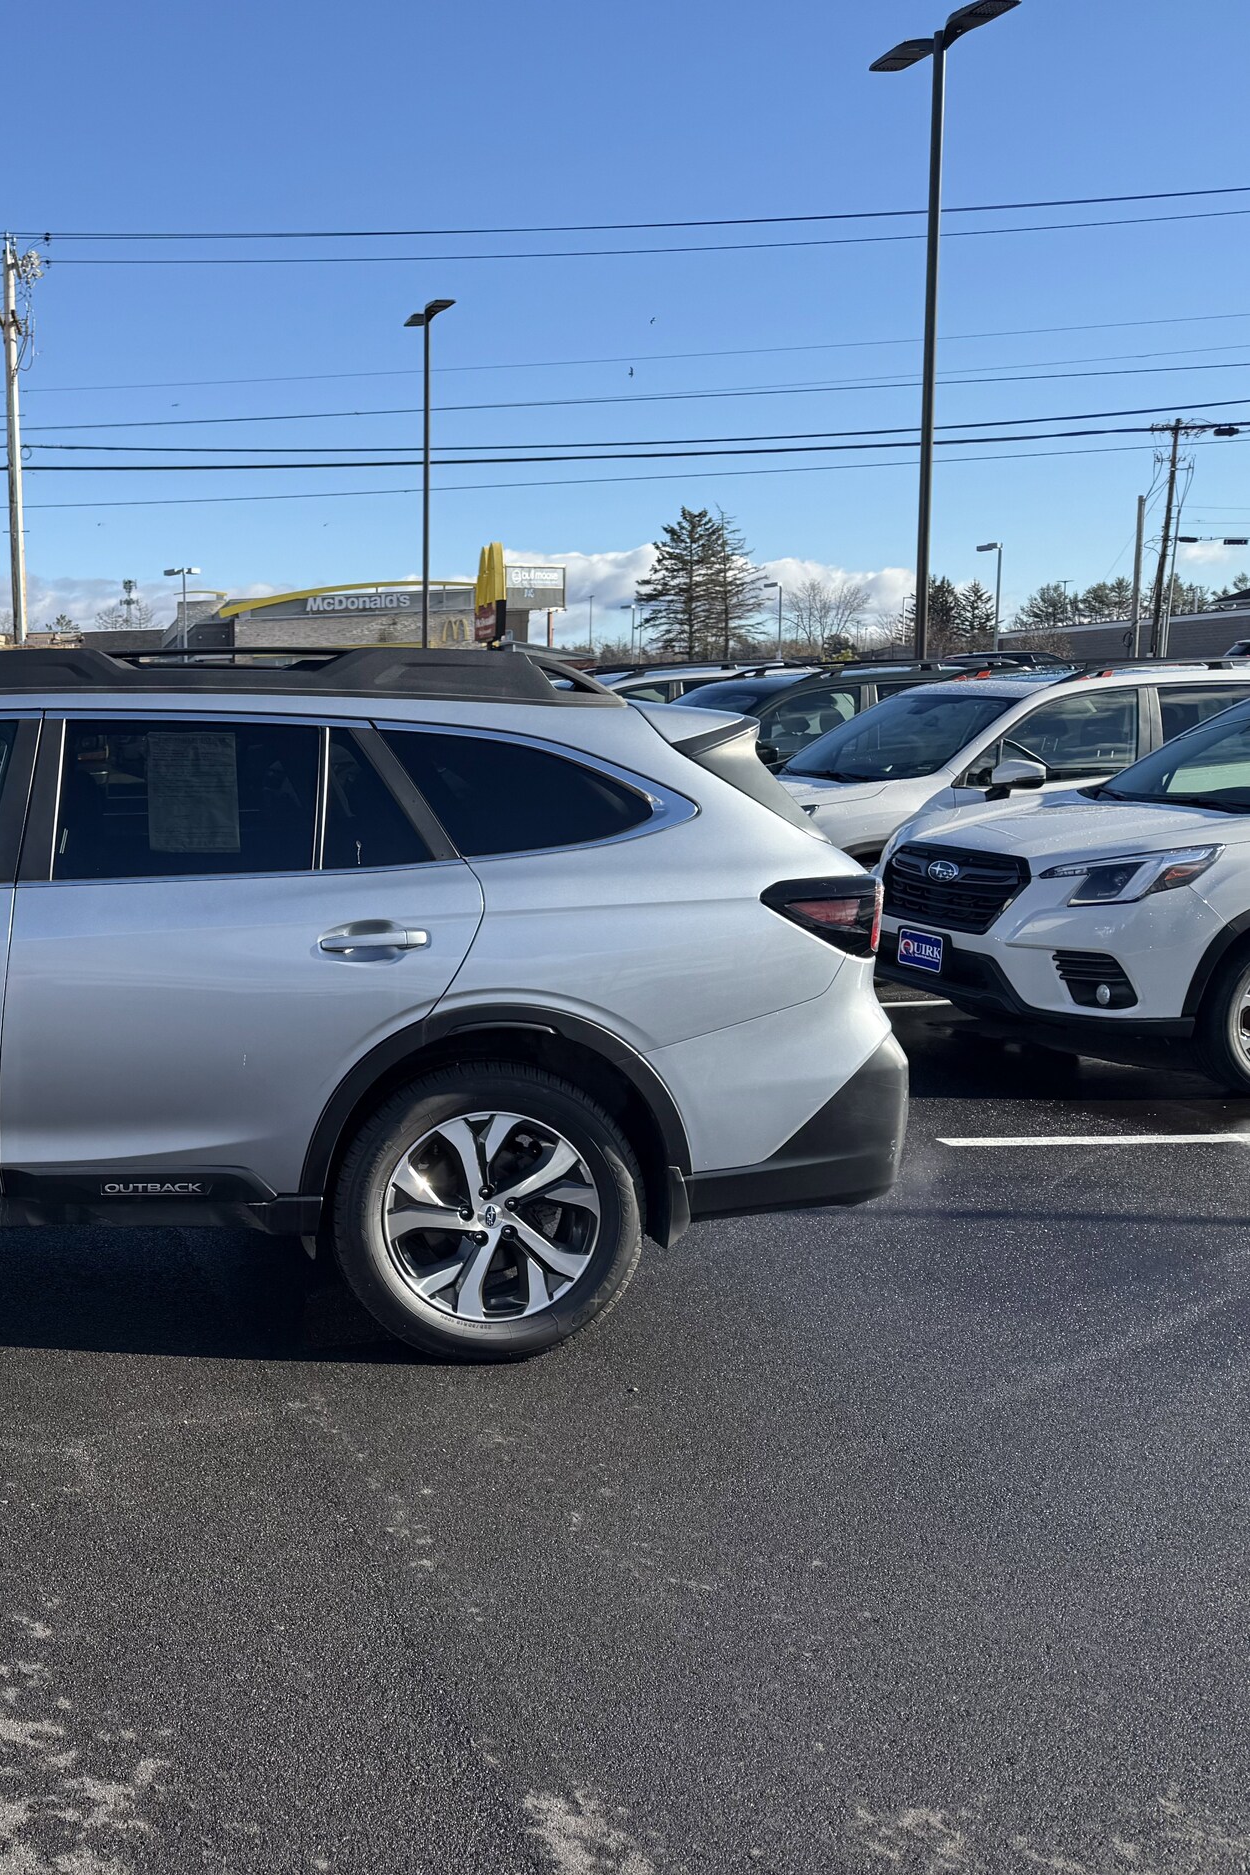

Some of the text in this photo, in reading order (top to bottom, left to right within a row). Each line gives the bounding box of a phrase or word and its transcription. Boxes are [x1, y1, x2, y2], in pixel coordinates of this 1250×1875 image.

[306, 593, 410, 611] McDonald's
[901, 939, 940, 959] QUIRK
[104, 1183, 202, 1192] OUTBACK
